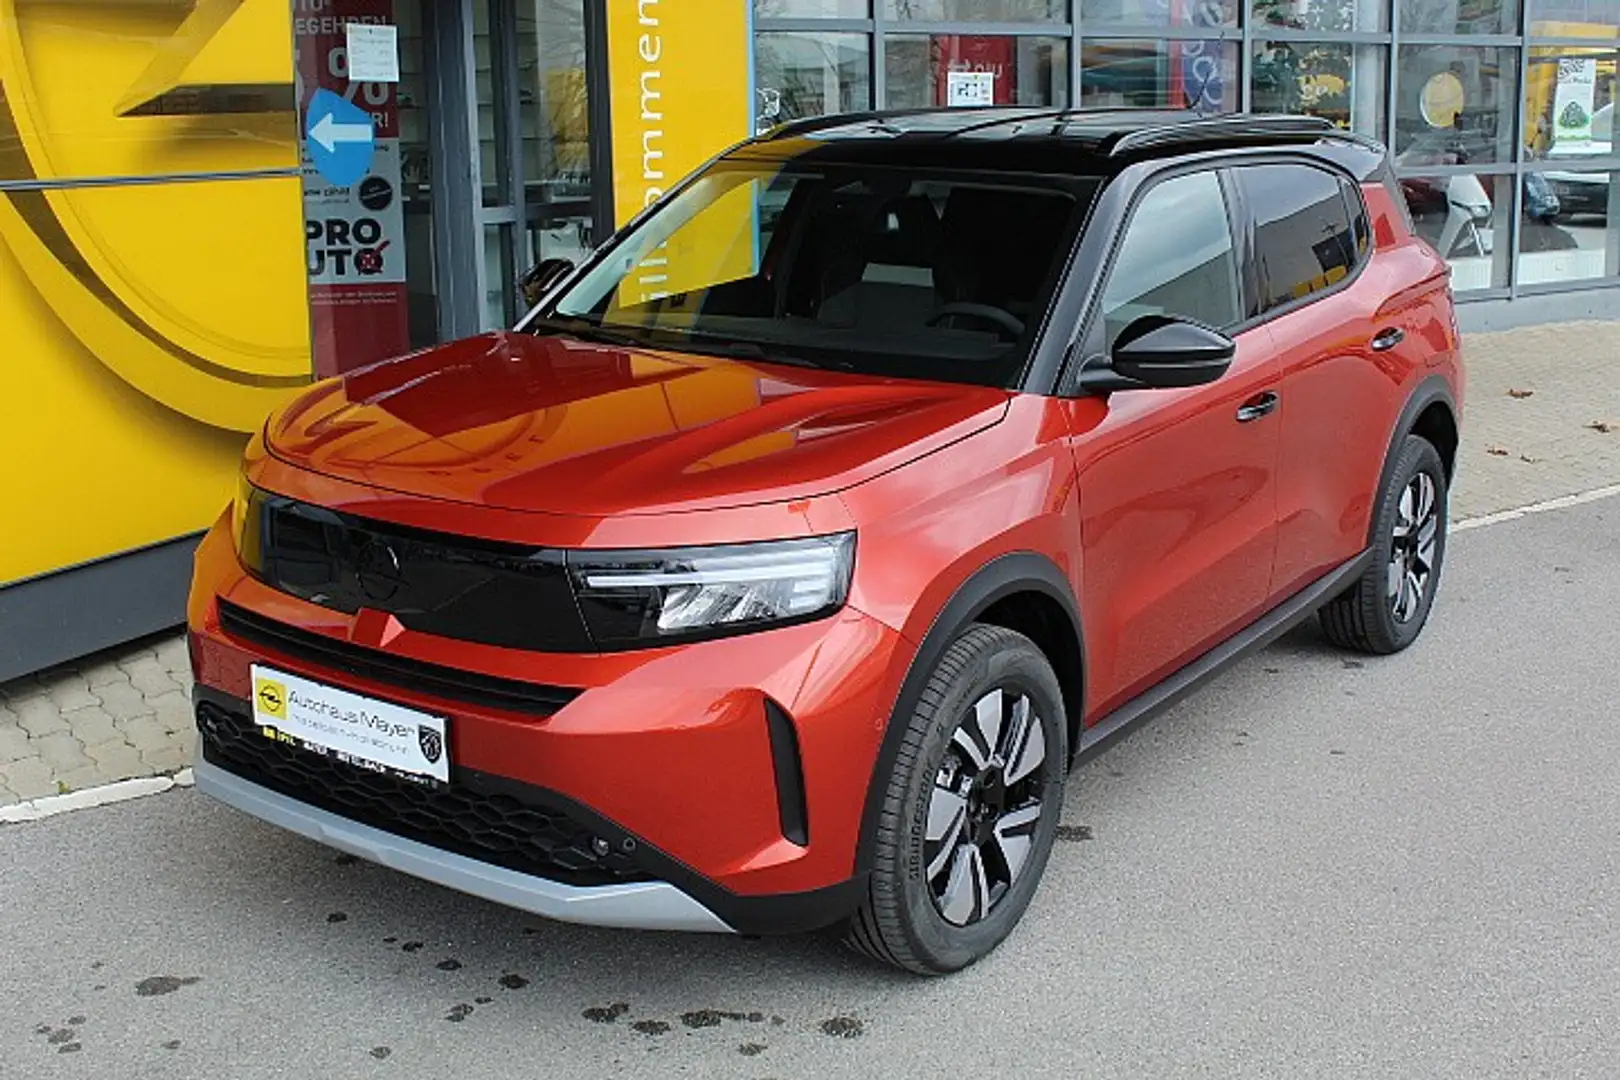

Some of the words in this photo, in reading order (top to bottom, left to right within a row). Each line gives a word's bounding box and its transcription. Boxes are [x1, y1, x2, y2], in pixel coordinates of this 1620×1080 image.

[306, 218, 382, 246] PRO
[288, 690, 359, 725] Autohaus
[360, 710, 416, 738] Mayer
